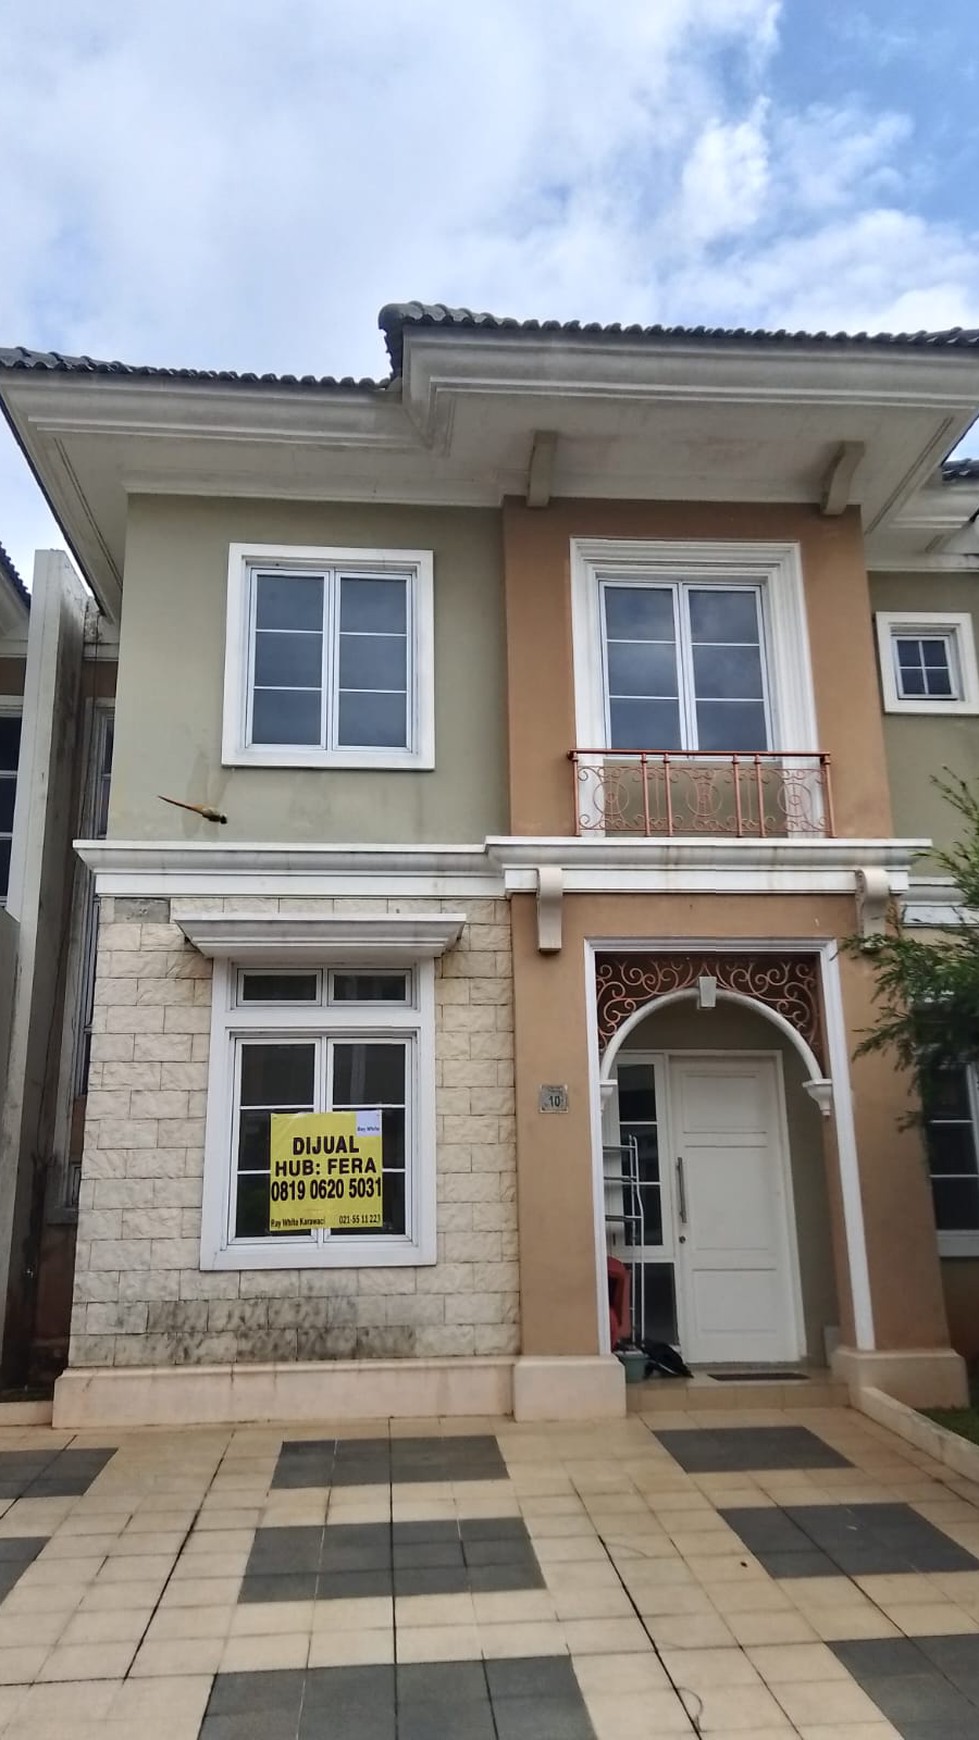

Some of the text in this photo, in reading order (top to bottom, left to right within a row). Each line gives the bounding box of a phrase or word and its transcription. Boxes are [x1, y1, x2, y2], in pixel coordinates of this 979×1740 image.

[550, 1095, 561, 1107] 10
[293, 1135, 359, 1155] DIJUAL
[275, 1157, 377, 1177] HUB: FERA
[271, 1177, 381, 1202] 0819 0620 5031
